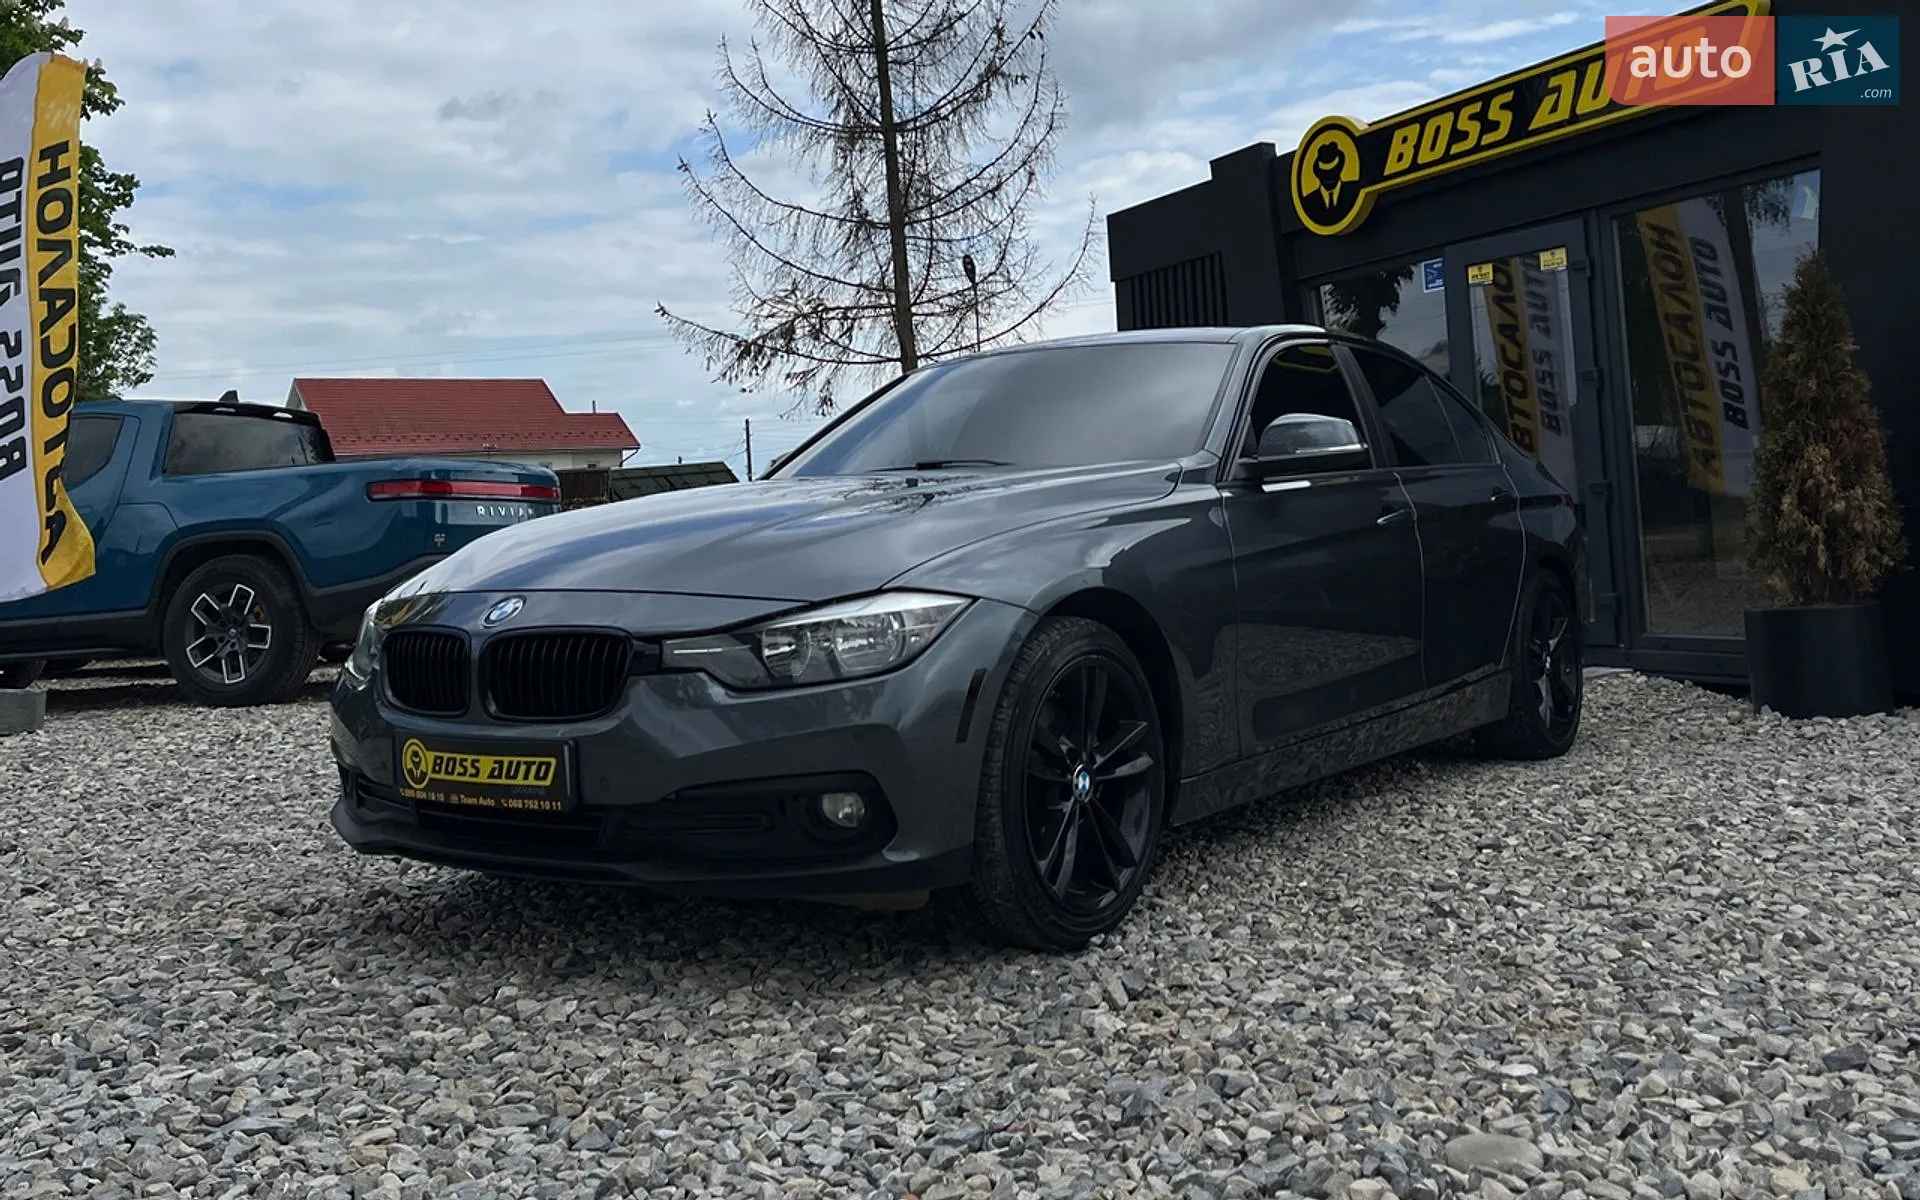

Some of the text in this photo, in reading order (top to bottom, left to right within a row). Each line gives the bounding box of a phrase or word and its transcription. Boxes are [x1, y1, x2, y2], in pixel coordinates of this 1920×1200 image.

[1383, 91, 1513, 176] BOSS
[1491, 260, 1536, 454] ВТОСАЛО
[1690, 235, 1748, 430] BOSS AUTO
[1533, 349, 1562, 437] BOSS
[431, 755, 552, 781] BOSS AUTO
